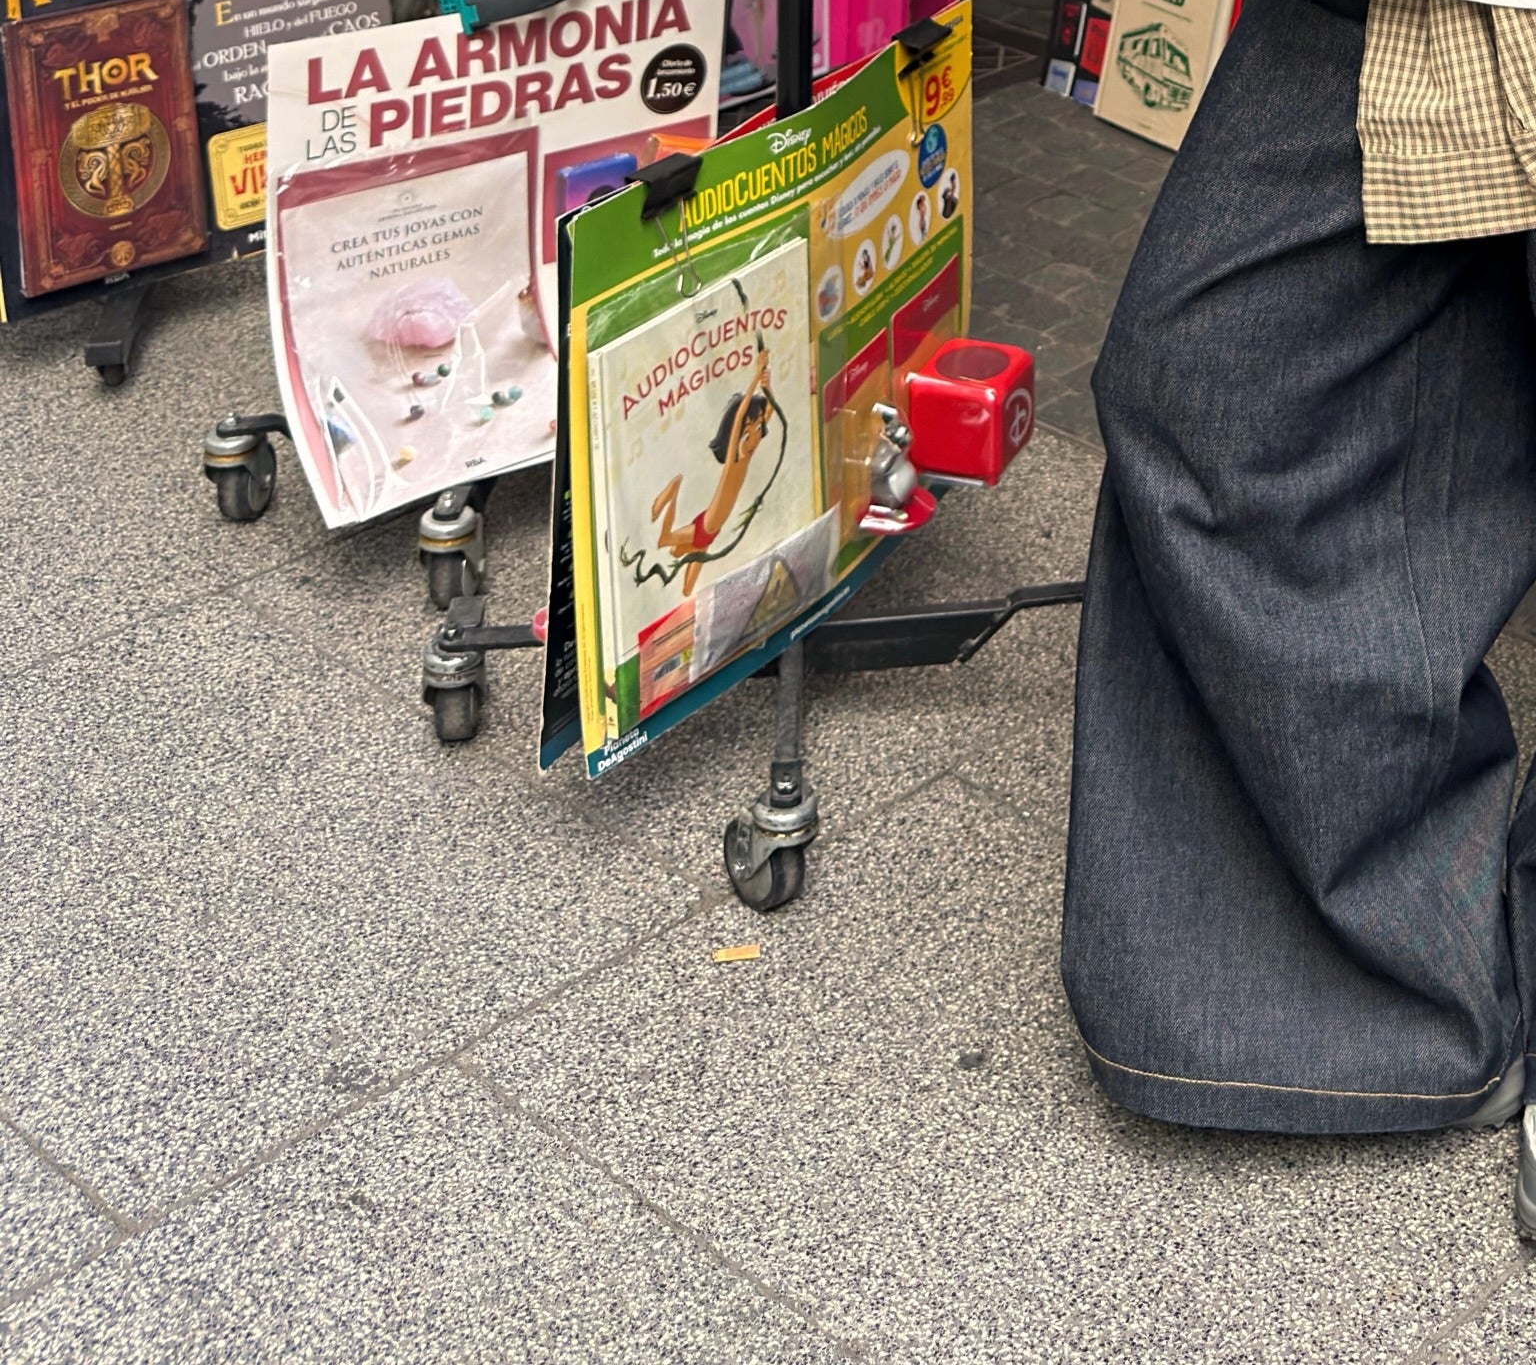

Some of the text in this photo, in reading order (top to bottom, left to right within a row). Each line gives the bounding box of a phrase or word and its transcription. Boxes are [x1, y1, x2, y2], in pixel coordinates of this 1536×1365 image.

[244, 1, 357, 38] HIELO FUEGO
[55, 51, 158, 95] THOR
[308, 48, 388, 105] LA
[307, 54, 633, 160] LAS PIEDRAS
[323, 110, 357, 130] DE
[822, 106, 867, 163] MÁGICOS
[332, 207, 484, 254] CREA TUS JOYAS CON
[337, 222, 481, 271] AUTÉNTICAS GEMAS
[370, 249, 452, 280] NATURALES
[655, 344, 753, 416] MÁGICOS
